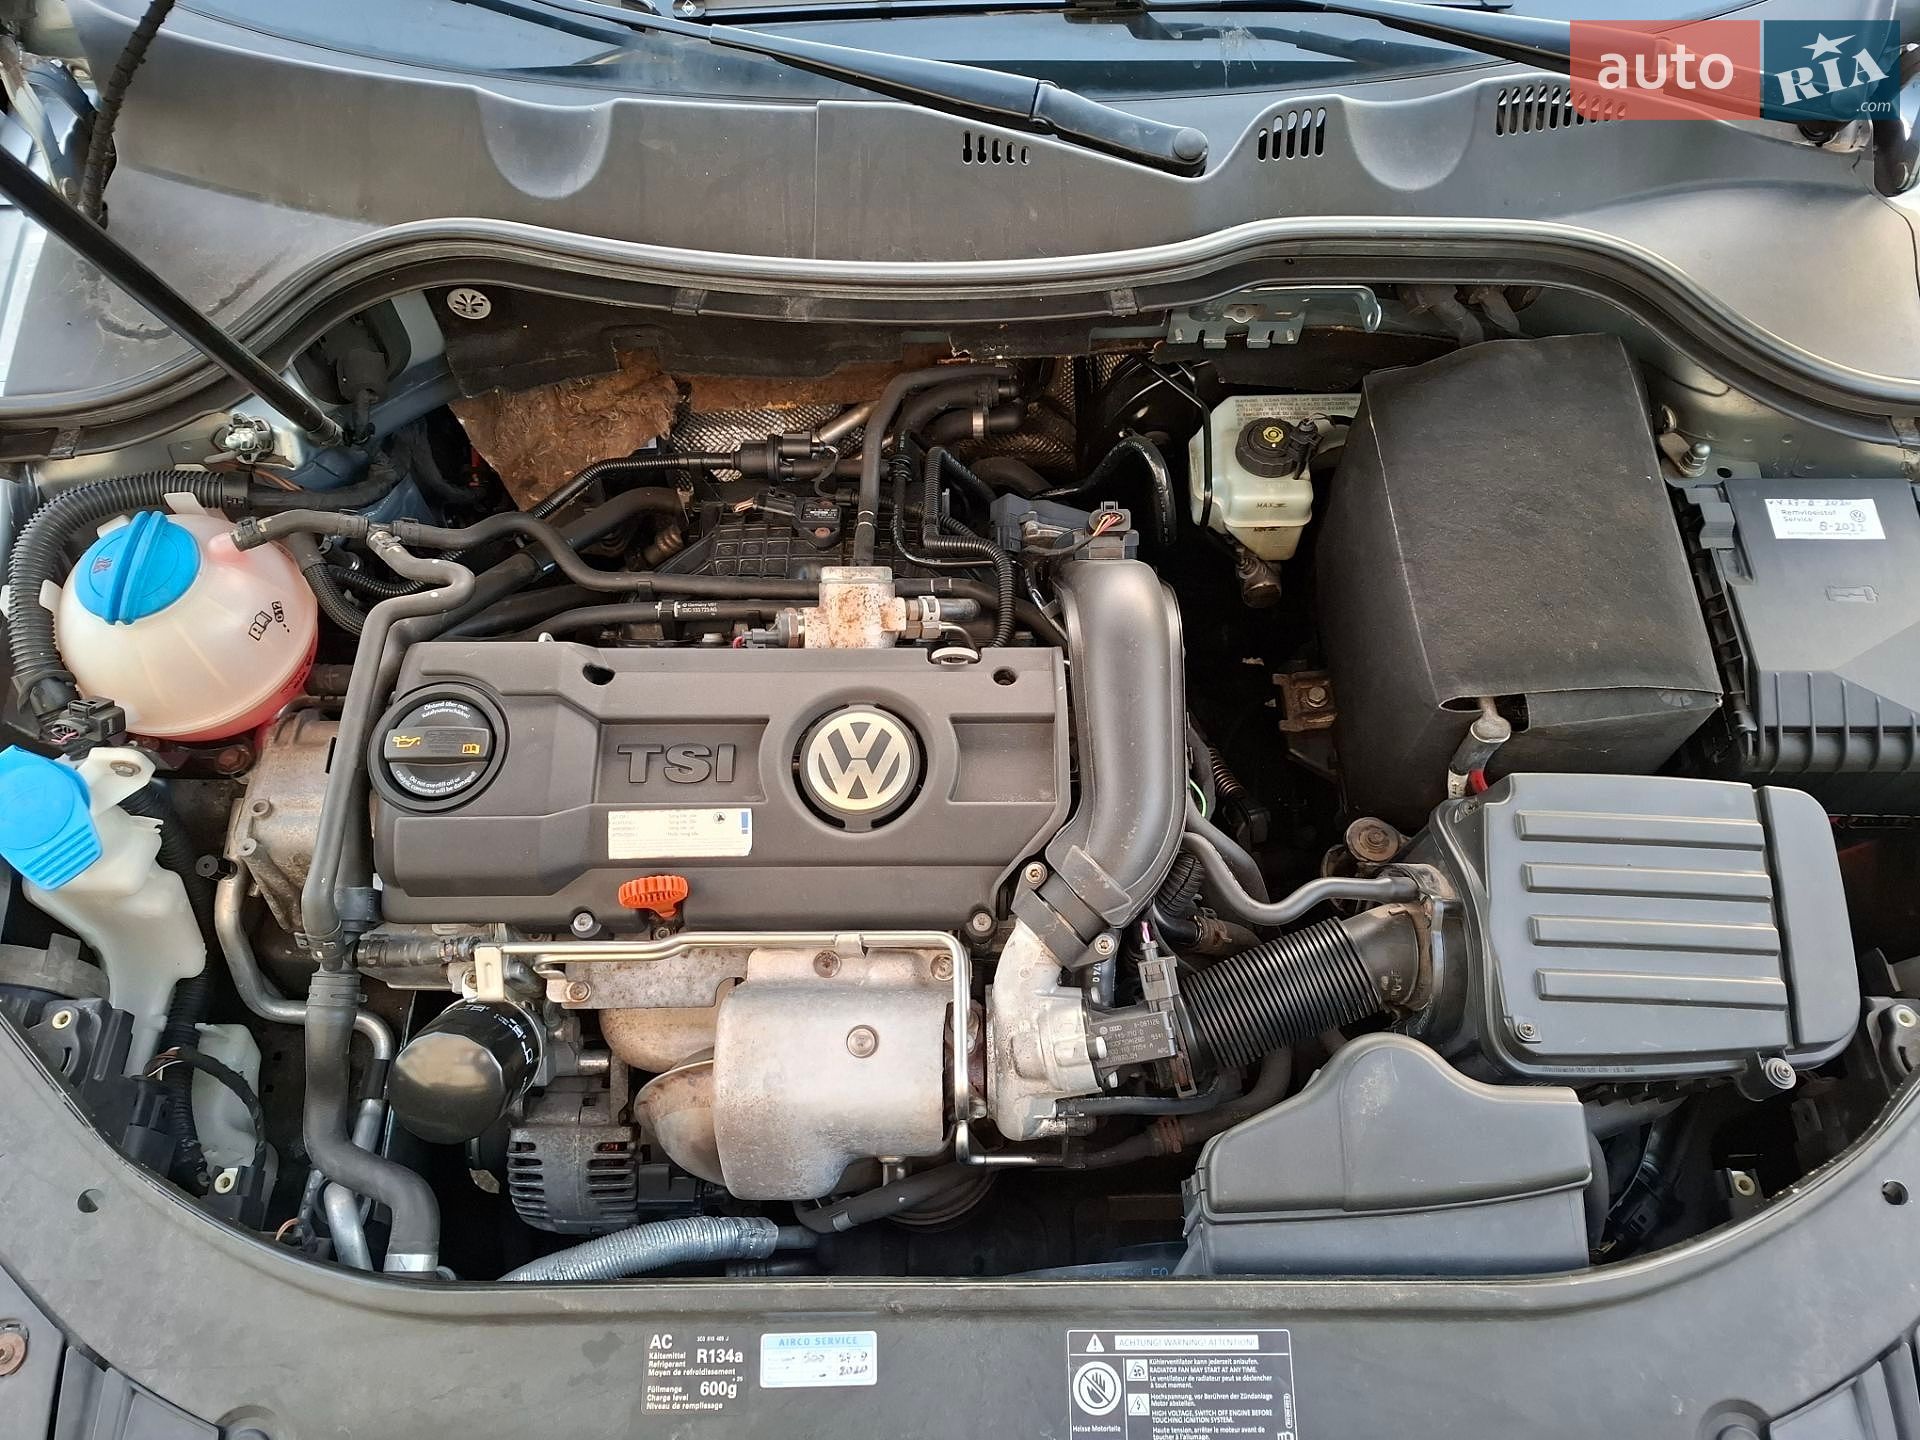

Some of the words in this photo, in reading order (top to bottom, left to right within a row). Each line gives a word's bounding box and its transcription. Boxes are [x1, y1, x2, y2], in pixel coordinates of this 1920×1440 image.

[617, 742, 737, 784] TSI
[649, 1334, 673, 1349] AC
[778, 1338, 810, 1346] AIRCO
[815, 1336, 857, 1345] SERVICE
[648, 1352, 686, 1360] Kältemittel
[696, 1348, 743, 1364] R134a
[648, 1360, 686, 1368] Refrigerant
[648, 1369, 671, 1377] Moyen
[683, 1368, 736, 1376] refroidissement
[647, 1385, 682, 1394] Füllmenge
[700, 1381, 738, 1399] 600g
[647, 1394, 671, 1402] Charge
[672, 1393, 689, 1401] level
[646, 1402, 670, 1410] Niveau
[672, 1402, 681, 1410] de
[682, 1402, 723, 1411] remplissage
